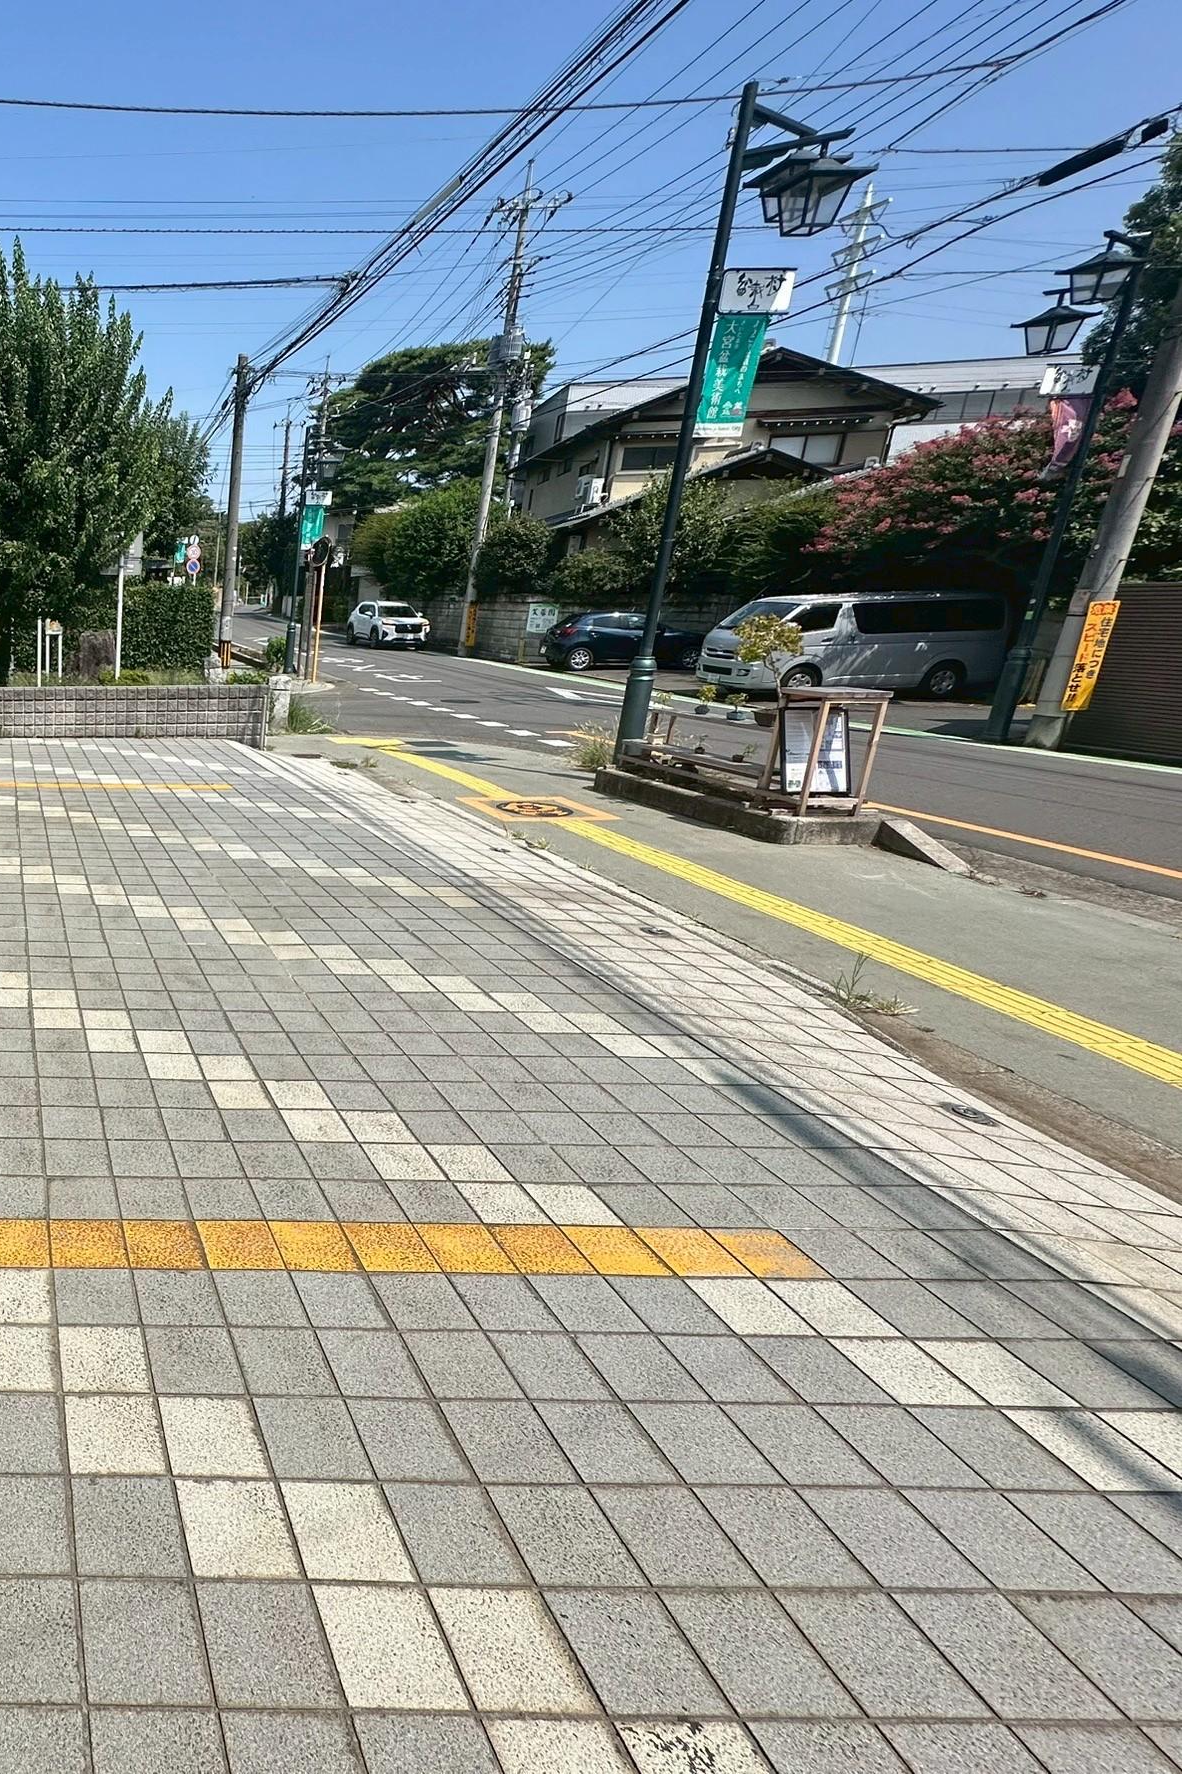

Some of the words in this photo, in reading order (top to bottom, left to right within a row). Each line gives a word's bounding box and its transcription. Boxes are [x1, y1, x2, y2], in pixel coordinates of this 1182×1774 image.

[706, 320, 738, 420] 大宮盆栽美術館
[1086, 617, 1113, 679] 住宅地につき
